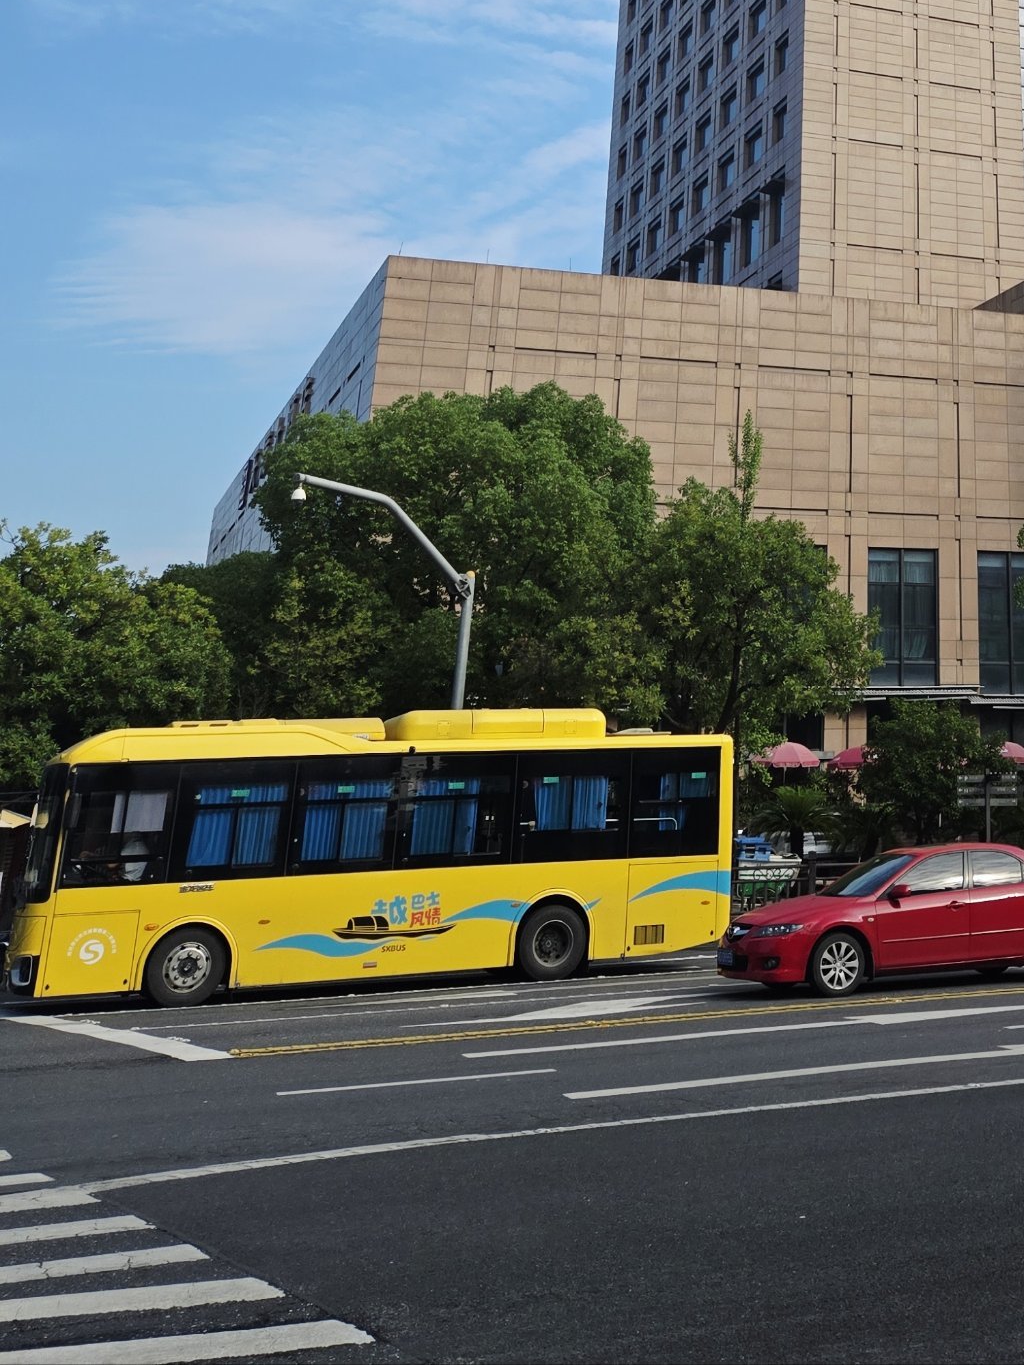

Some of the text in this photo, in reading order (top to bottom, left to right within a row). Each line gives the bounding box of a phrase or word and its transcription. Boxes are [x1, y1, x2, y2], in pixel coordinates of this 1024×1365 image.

[411, 891, 441, 911] 巴士
[409, 907, 441, 928] 风情
[381, 944, 407, 953] SXBUS
